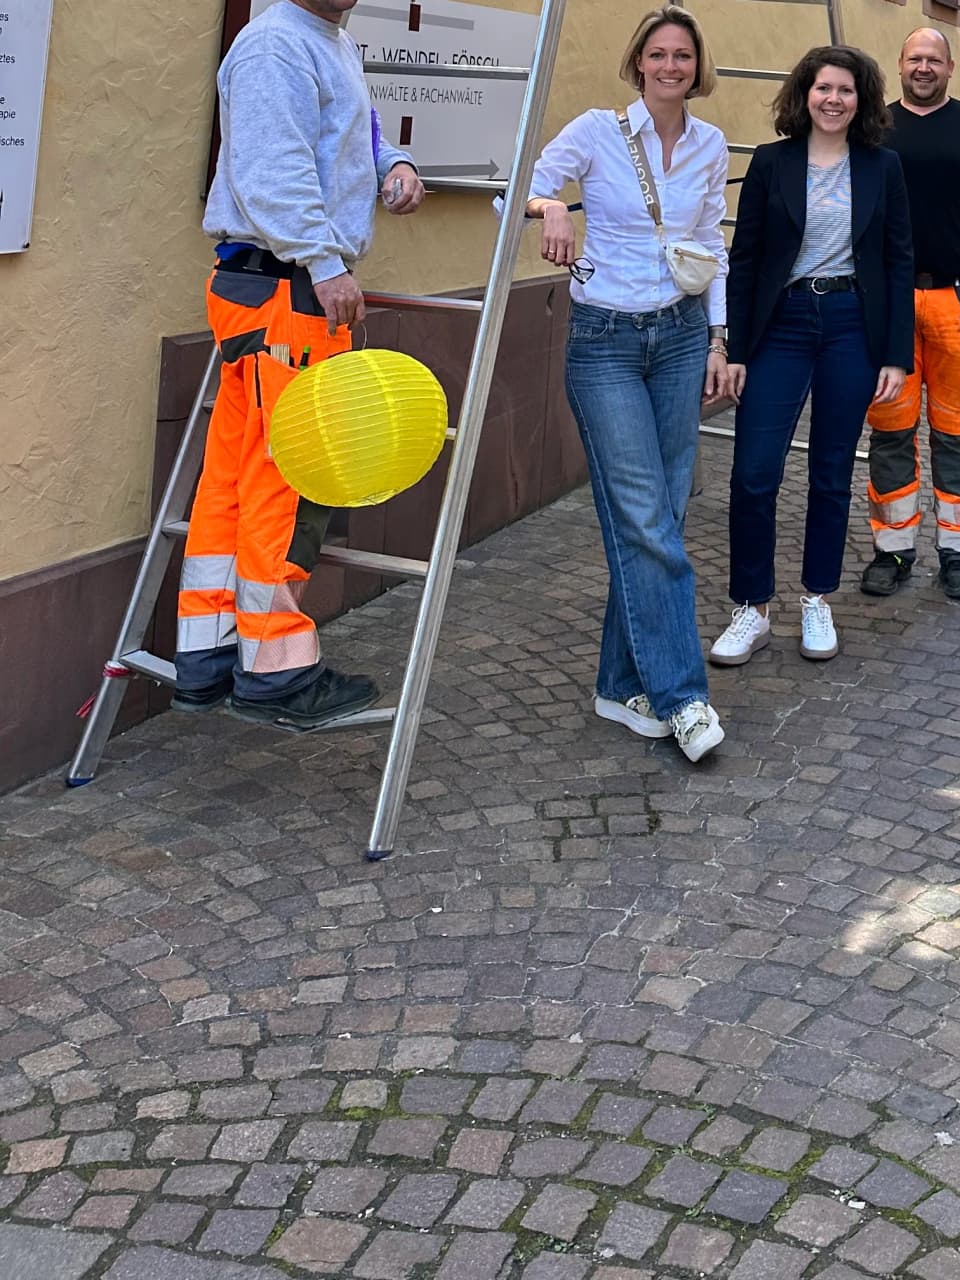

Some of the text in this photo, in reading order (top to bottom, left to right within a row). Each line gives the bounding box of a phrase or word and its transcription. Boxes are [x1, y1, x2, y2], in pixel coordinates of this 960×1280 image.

[411, 87, 417, 102] &
[420, 87, 483, 105] FACHANWÄLTE
[623, 134, 655, 205] BOGNER
